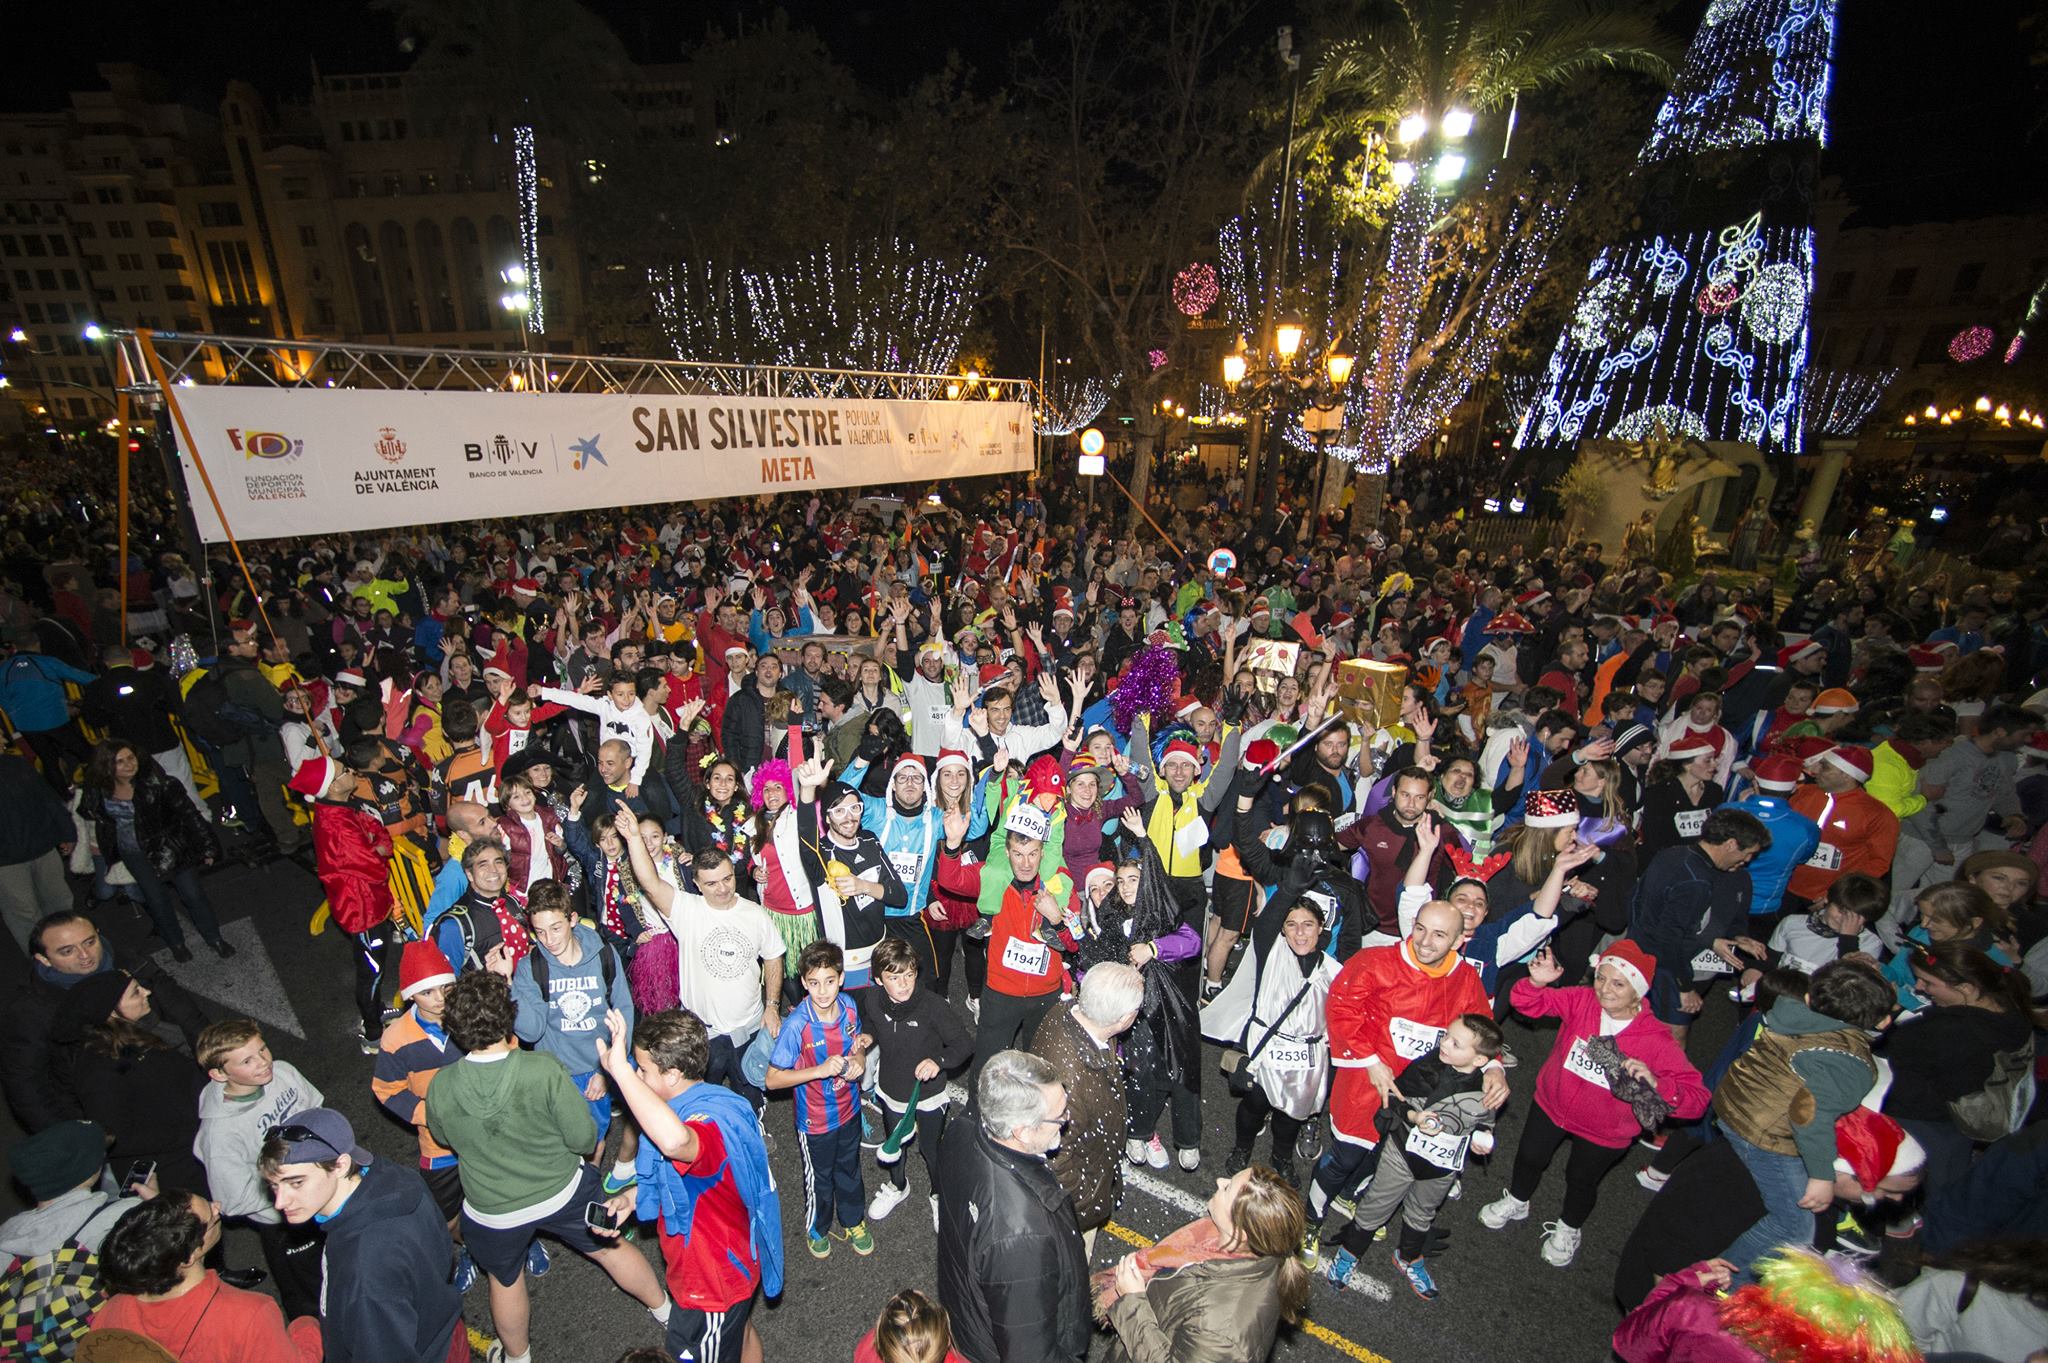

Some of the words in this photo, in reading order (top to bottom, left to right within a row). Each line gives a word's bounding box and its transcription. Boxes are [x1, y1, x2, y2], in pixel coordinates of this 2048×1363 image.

[845, 409, 880, 426] POPULAR
[632, 406, 700, 453] SAN
[708, 406, 842, 450] SILVESTRE
[464, 443, 483, 462] B
[521, 441, 538, 459] V
[354, 467, 436, 482] AJUNTAMENT
[761, 456, 816, 483] META
[356, 482, 374, 495] DE
[1010, 814, 1044, 835] 11950
[1006, 949, 1041, 967] 11947
[1268, 1049, 1308, 1062] 12536
[1412, 1133, 1456, 1159] 11729
